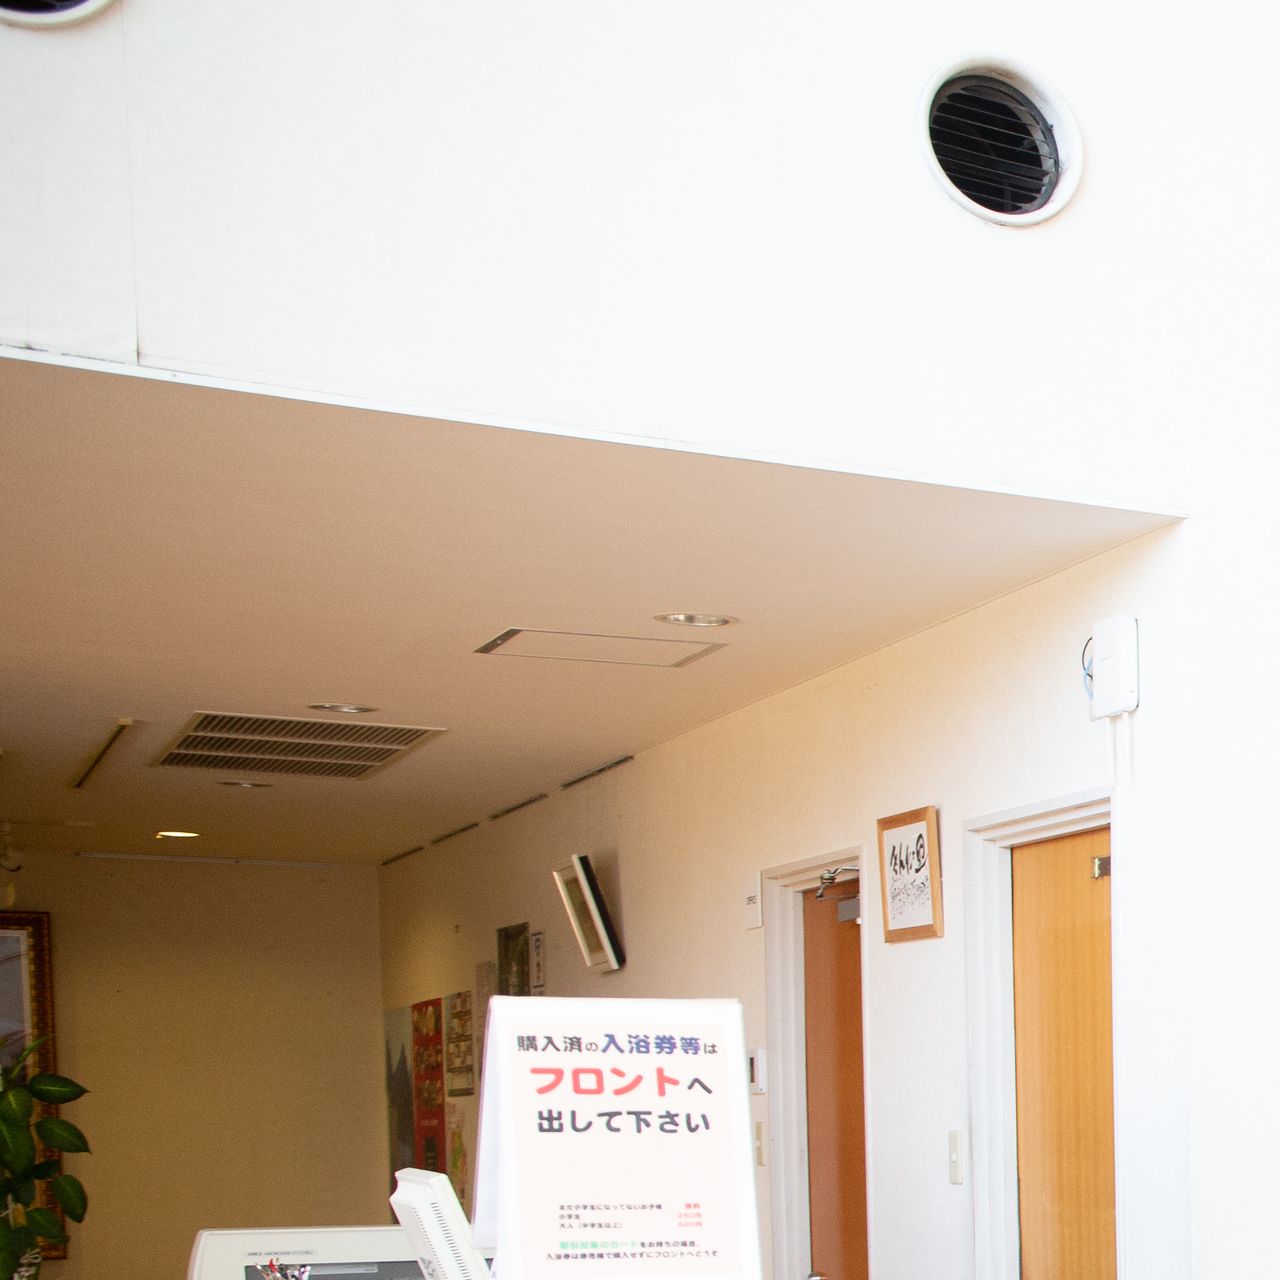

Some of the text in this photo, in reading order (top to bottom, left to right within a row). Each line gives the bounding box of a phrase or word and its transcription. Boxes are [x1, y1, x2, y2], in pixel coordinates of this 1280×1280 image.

[517, 1033, 719, 1056] 購入済の入浴券等は
[529, 1066, 714, 1098] フロントへ
[537, 1109, 711, 1135] 出して下さい
